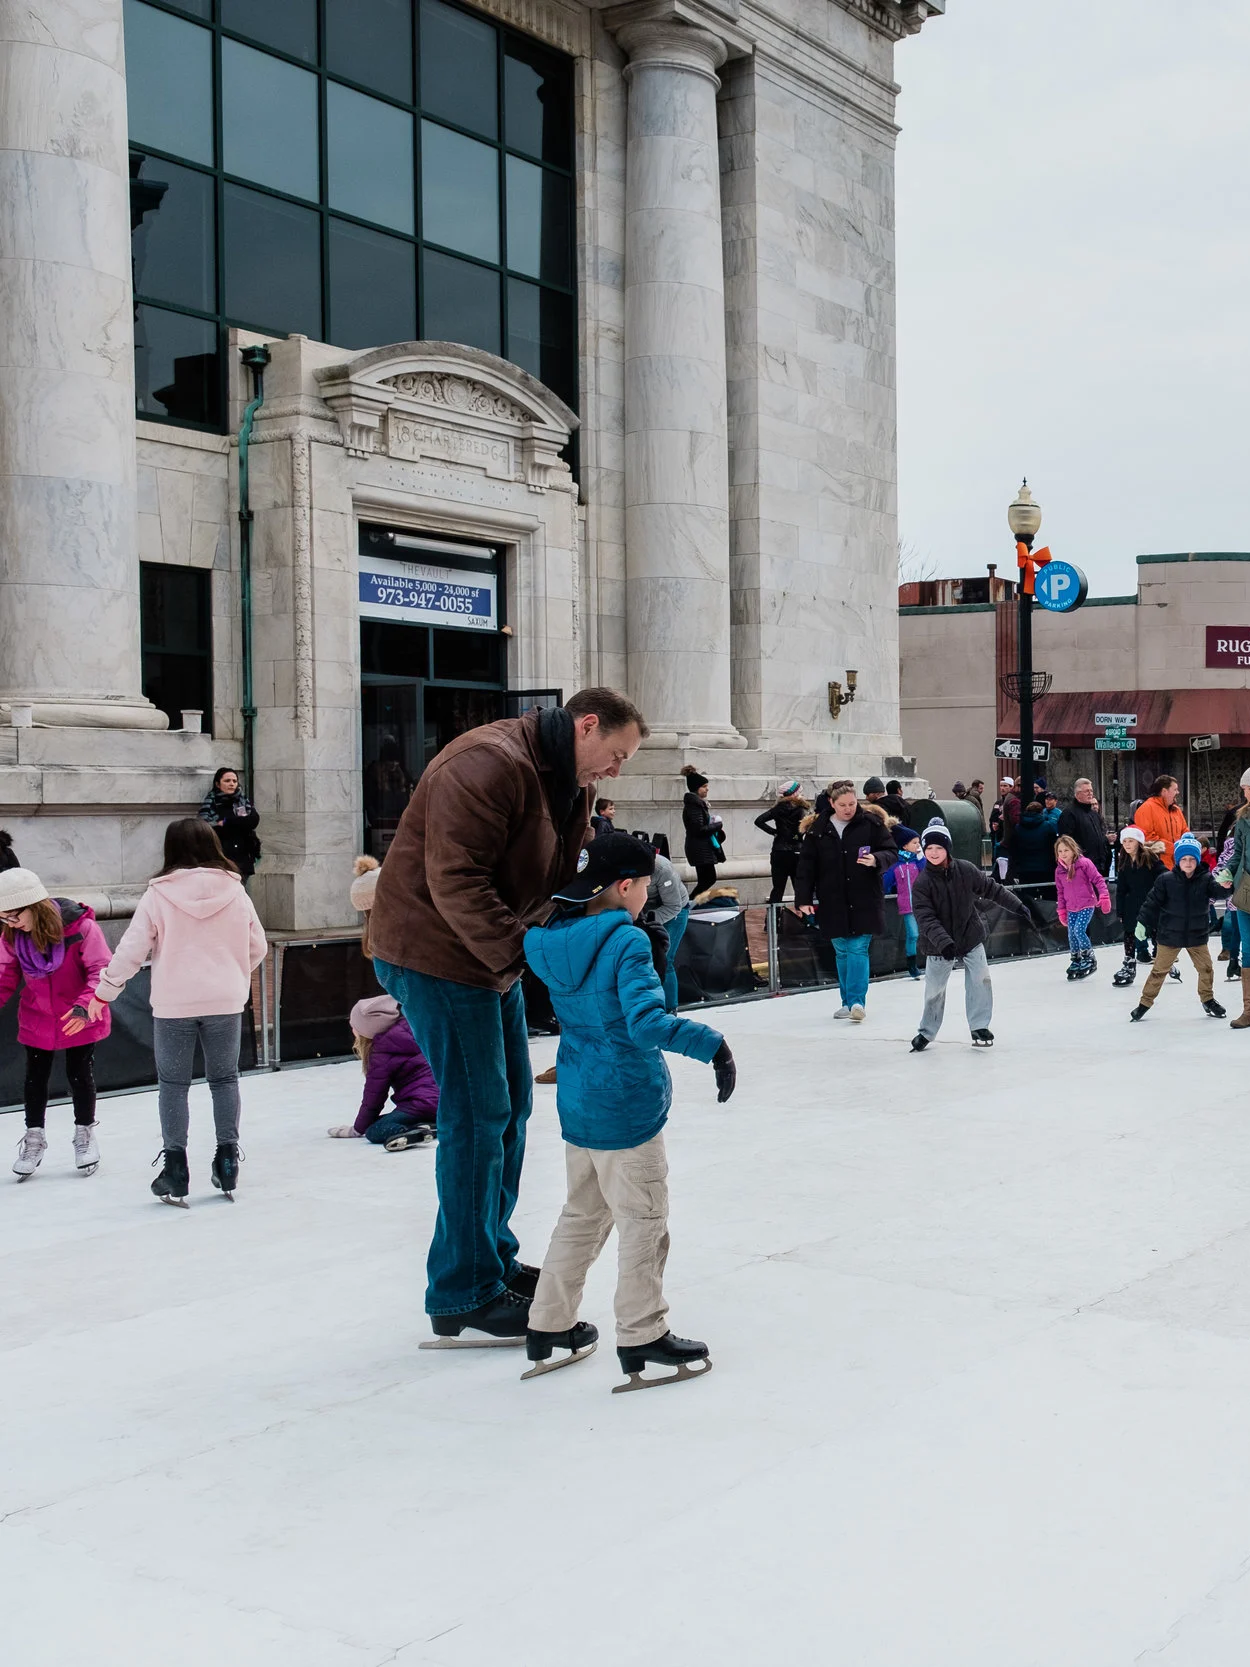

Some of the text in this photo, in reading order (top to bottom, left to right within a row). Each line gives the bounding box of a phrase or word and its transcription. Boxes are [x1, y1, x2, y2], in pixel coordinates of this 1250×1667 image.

[413, 428, 489, 456] CHARTERED
[1043, 564, 1071, 574] PUBLIC
[370, 575, 414, 590] Available
[414, 581, 437, 592] 5,000
[444, 585, 470, 597] 24,000
[471, 588, 480, 598] sf
[1050, 573, 1071, 600] P
[377, 587, 473, 614] 973-947-0055
[1044, 598, 1073, 609] PARKING
[1096, 740, 1121, 749] Wallace
